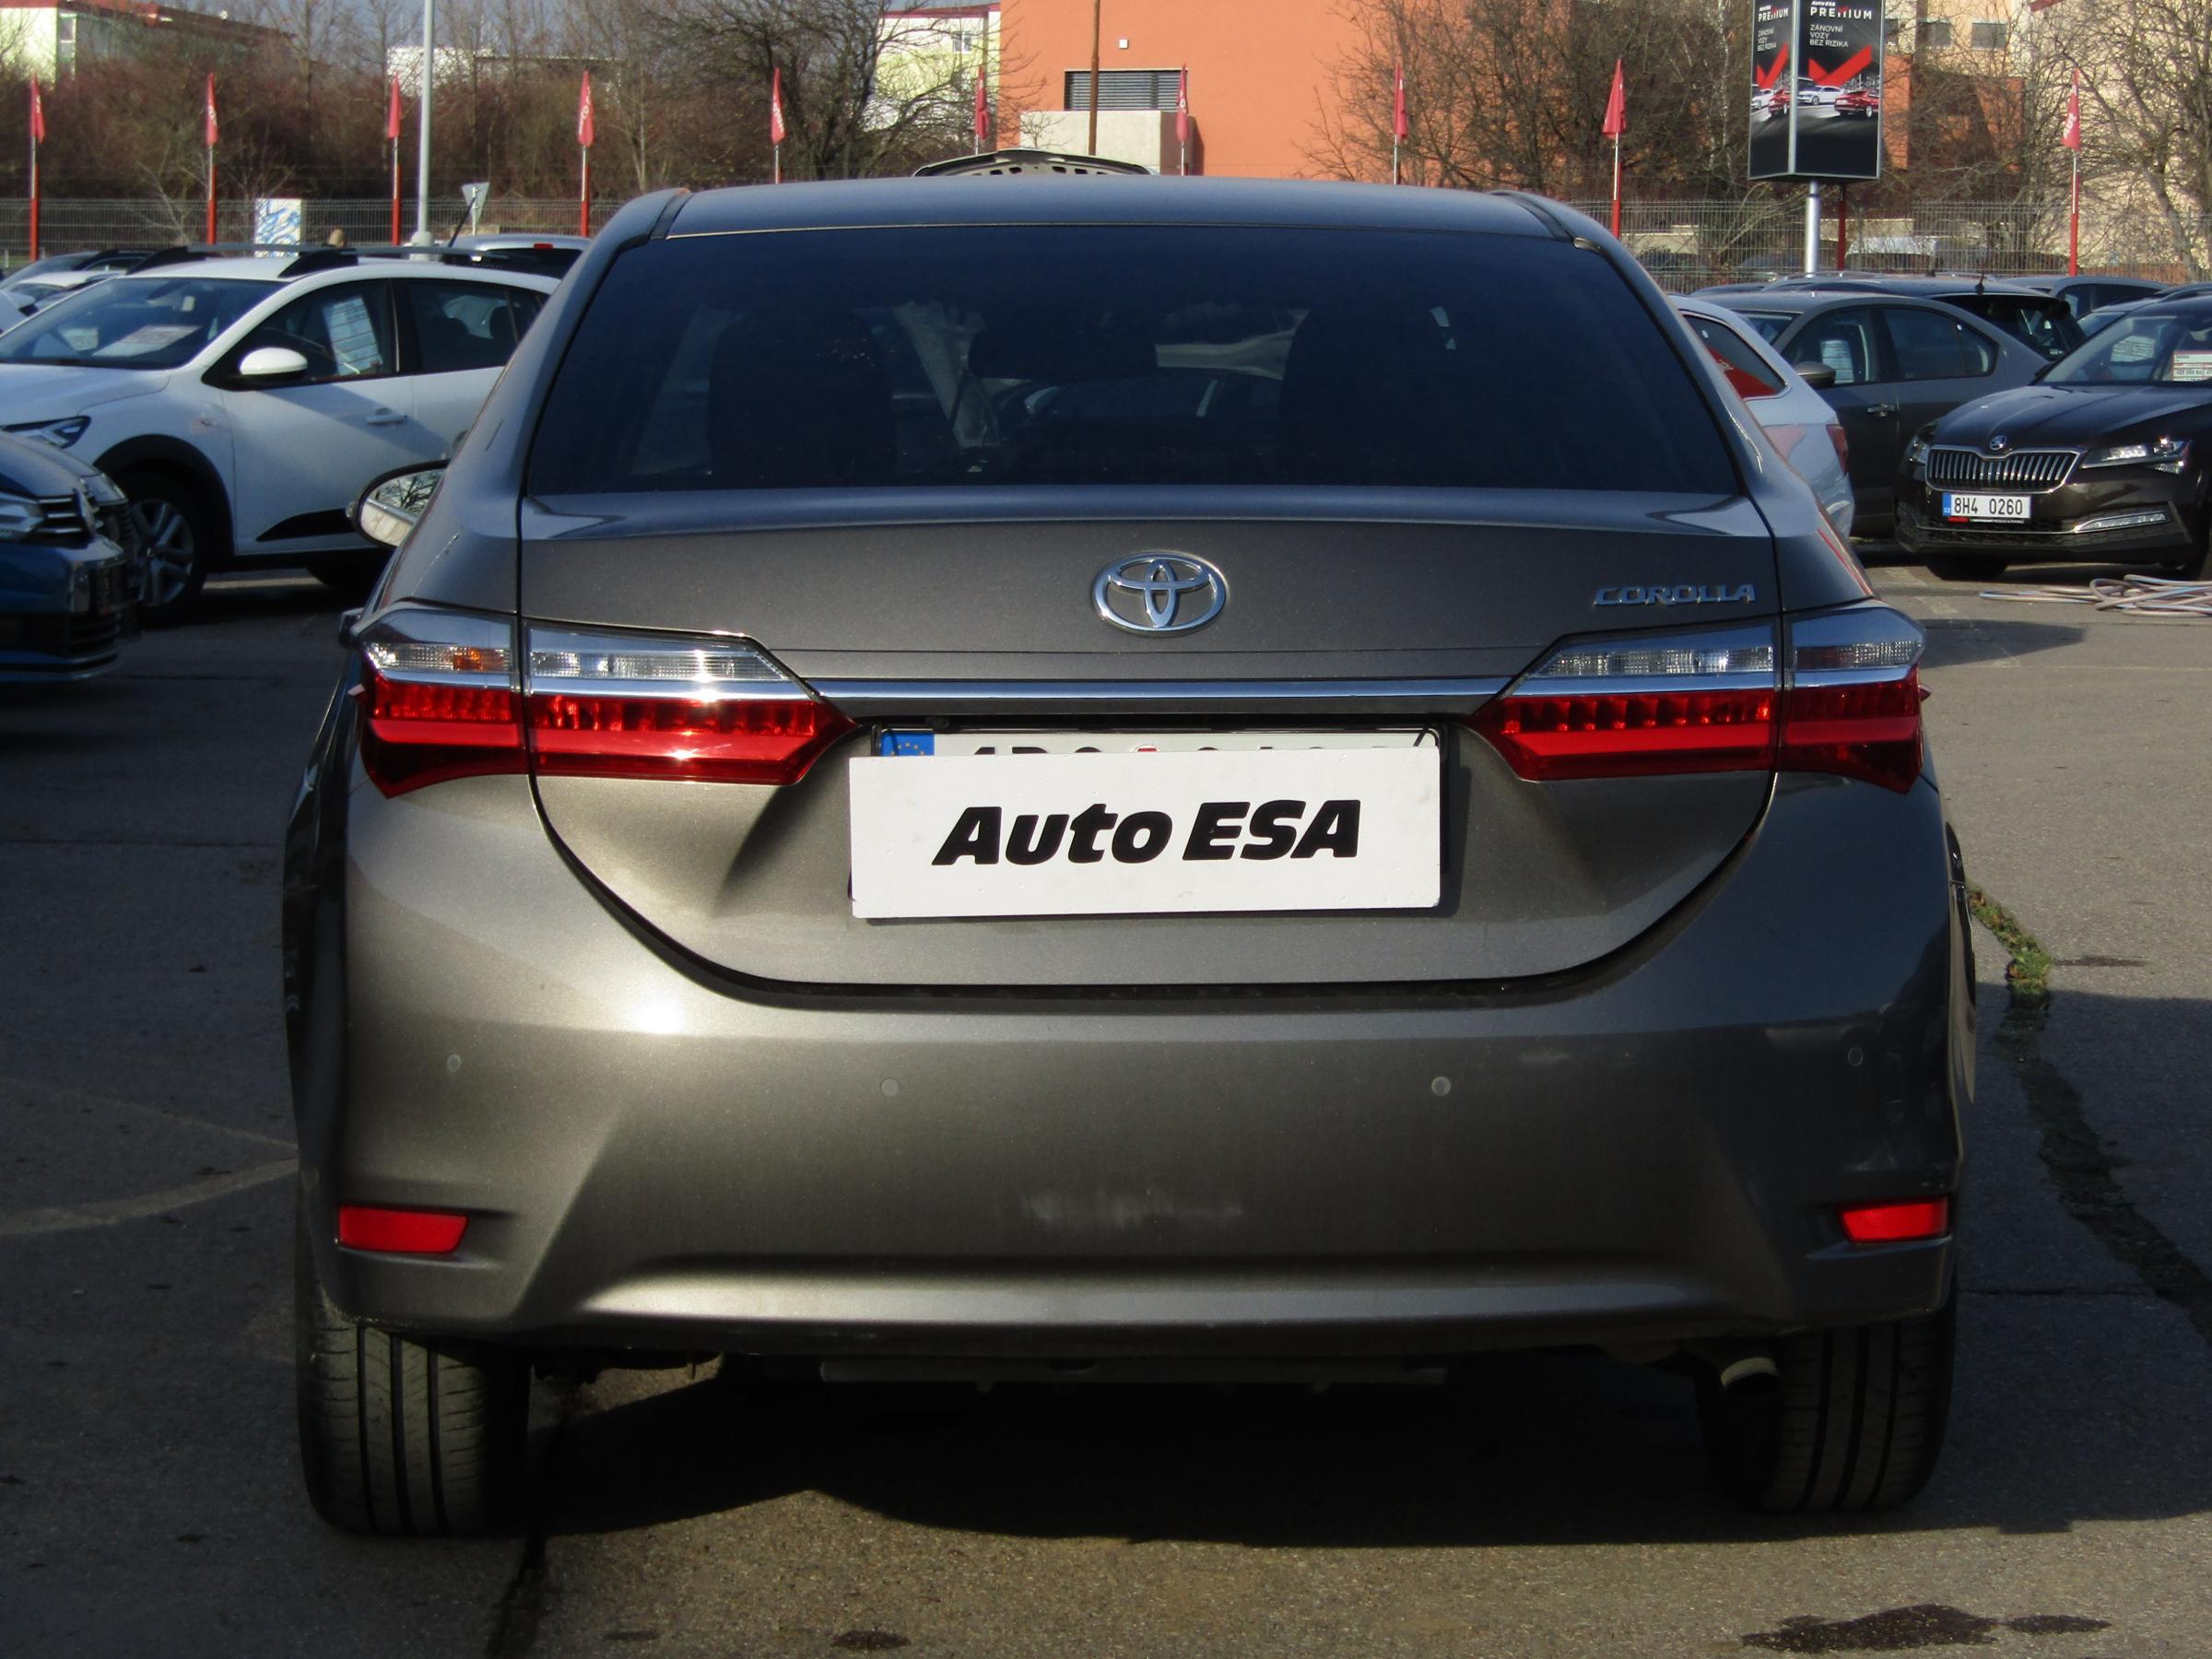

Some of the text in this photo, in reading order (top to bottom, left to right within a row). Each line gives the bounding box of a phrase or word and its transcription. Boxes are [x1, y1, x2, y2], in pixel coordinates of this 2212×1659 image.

[1954, 497, 2023, 515] 8H4 0260
[1594, 583, 1756, 606] COROLLA
[932, 799, 1361, 865] Auto ESA
